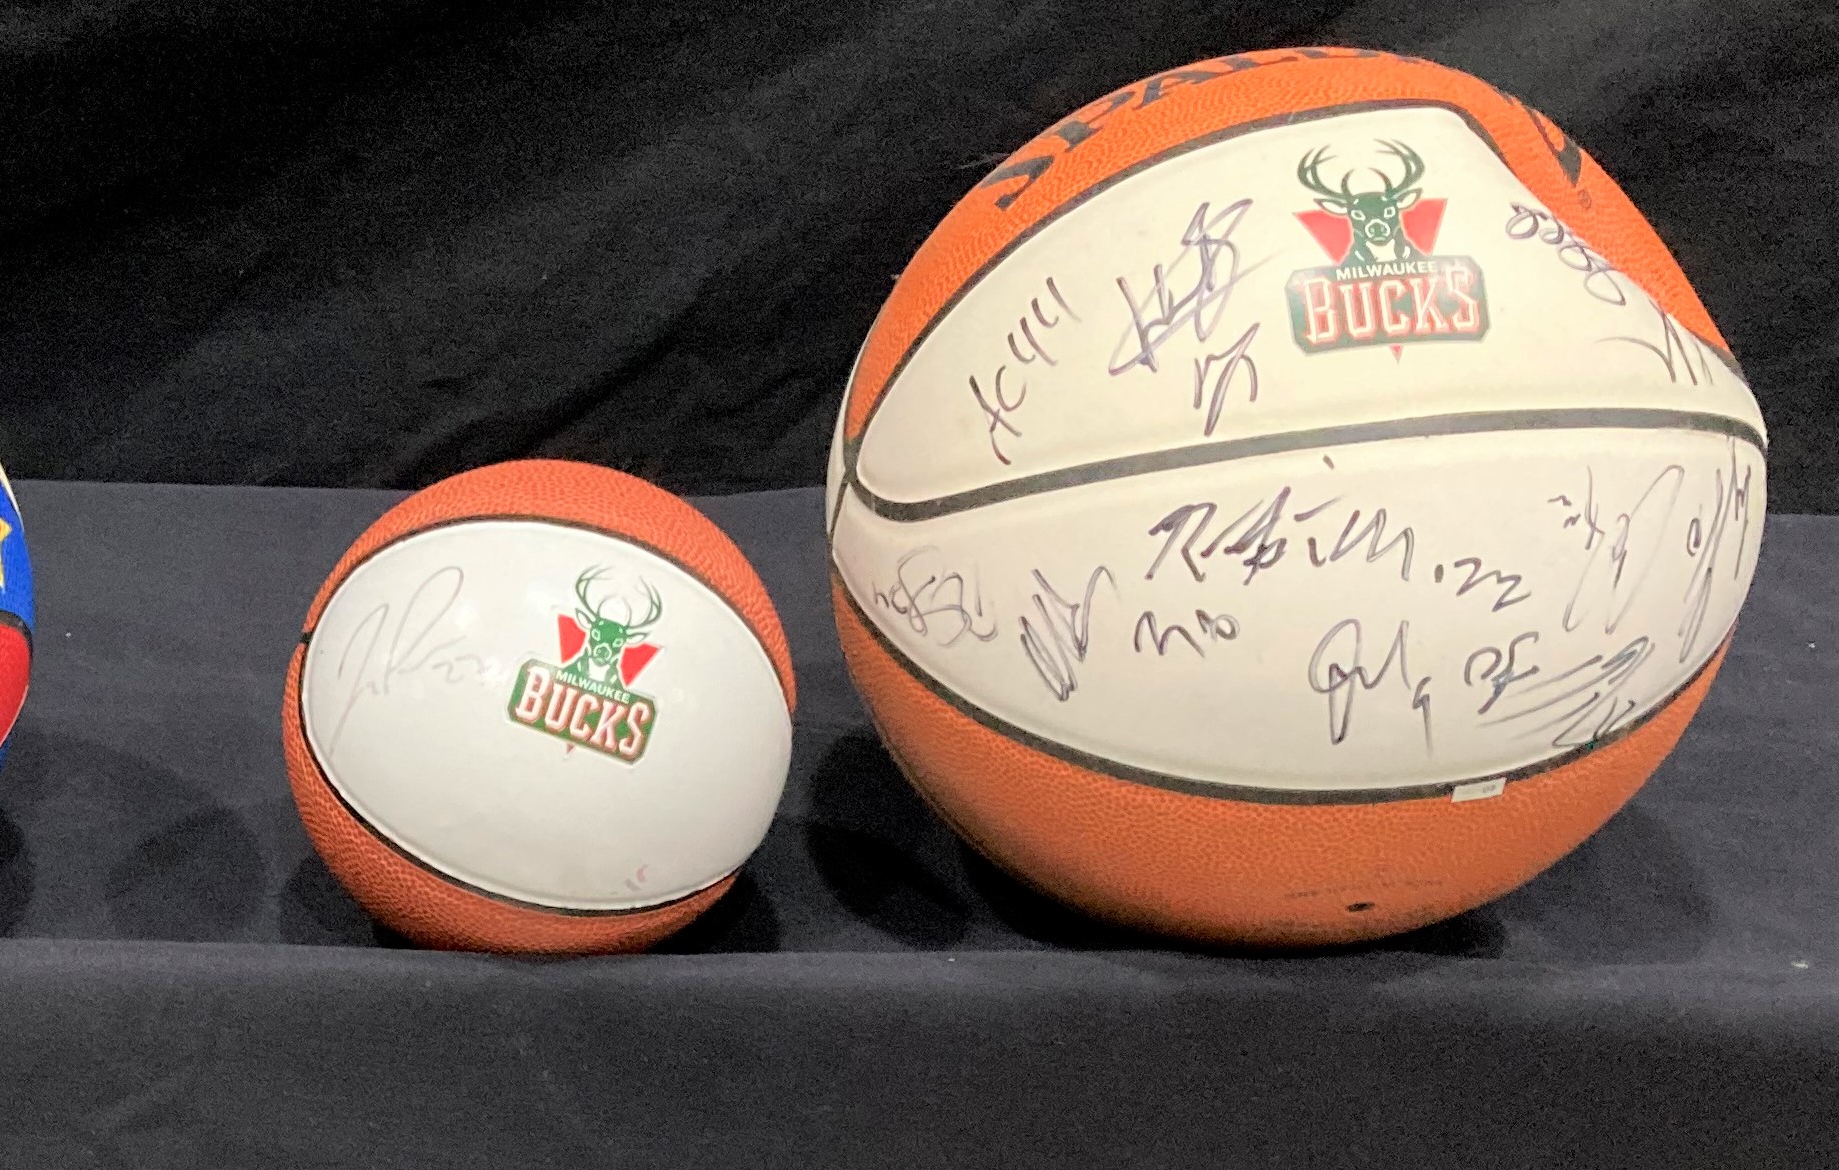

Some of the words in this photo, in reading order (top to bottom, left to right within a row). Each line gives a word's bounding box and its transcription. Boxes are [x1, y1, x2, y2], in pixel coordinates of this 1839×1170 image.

[1335, 261, 1438, 281] MILWAUKEE
[1305, 263, 1481, 345] BUCKS
[515, 666, 651, 757] BUCKS
[556, 670, 631, 704] MILWAUKEE
